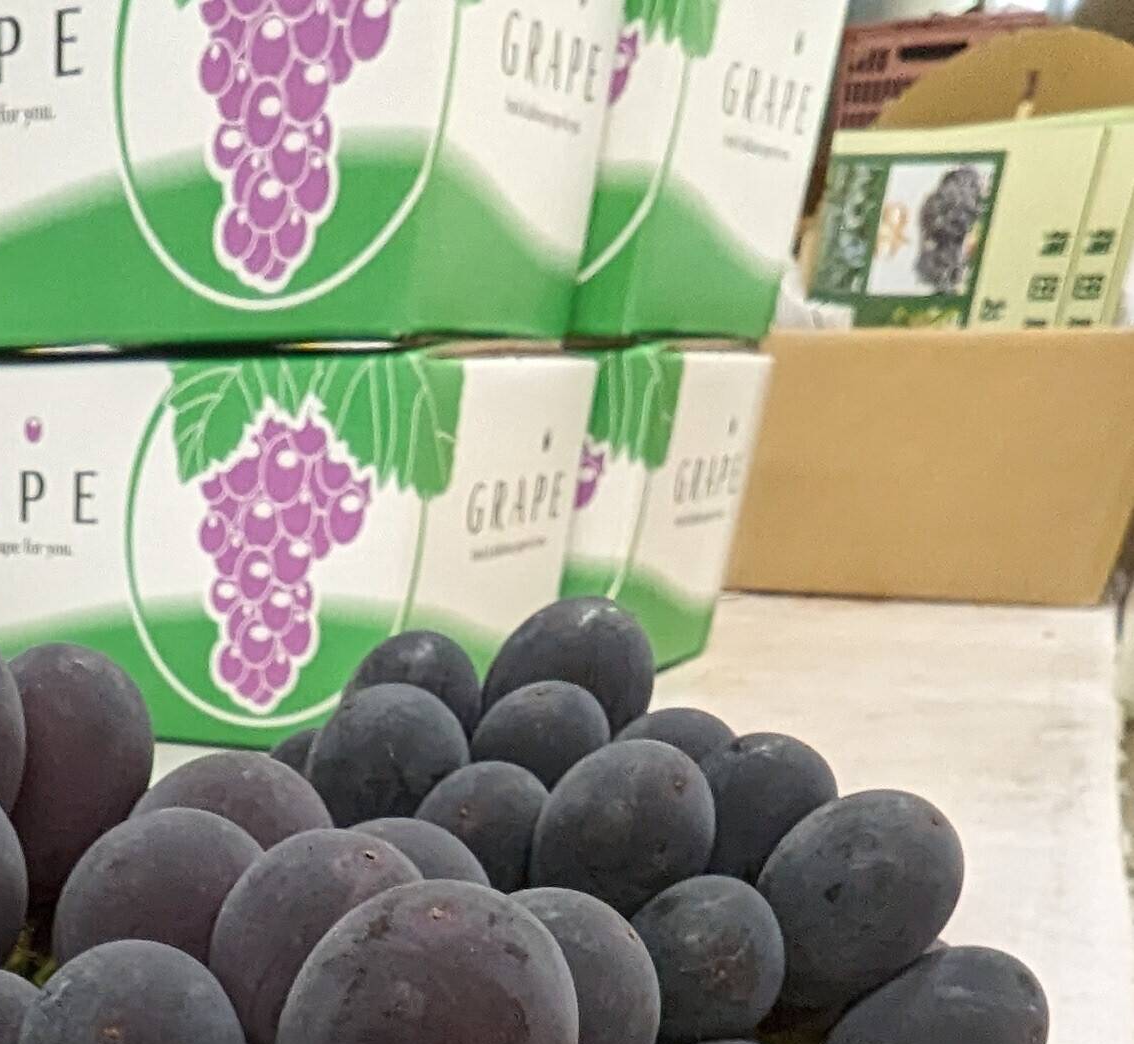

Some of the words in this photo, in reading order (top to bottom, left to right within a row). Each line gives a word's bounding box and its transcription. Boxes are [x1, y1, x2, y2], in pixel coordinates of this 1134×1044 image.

[500, 10, 602, 103] GRAPE
[721, 61, 814, 136] GRAPE
[466, 470, 566, 535] GRAPE
[673, 452, 742, 505] GRAPE
